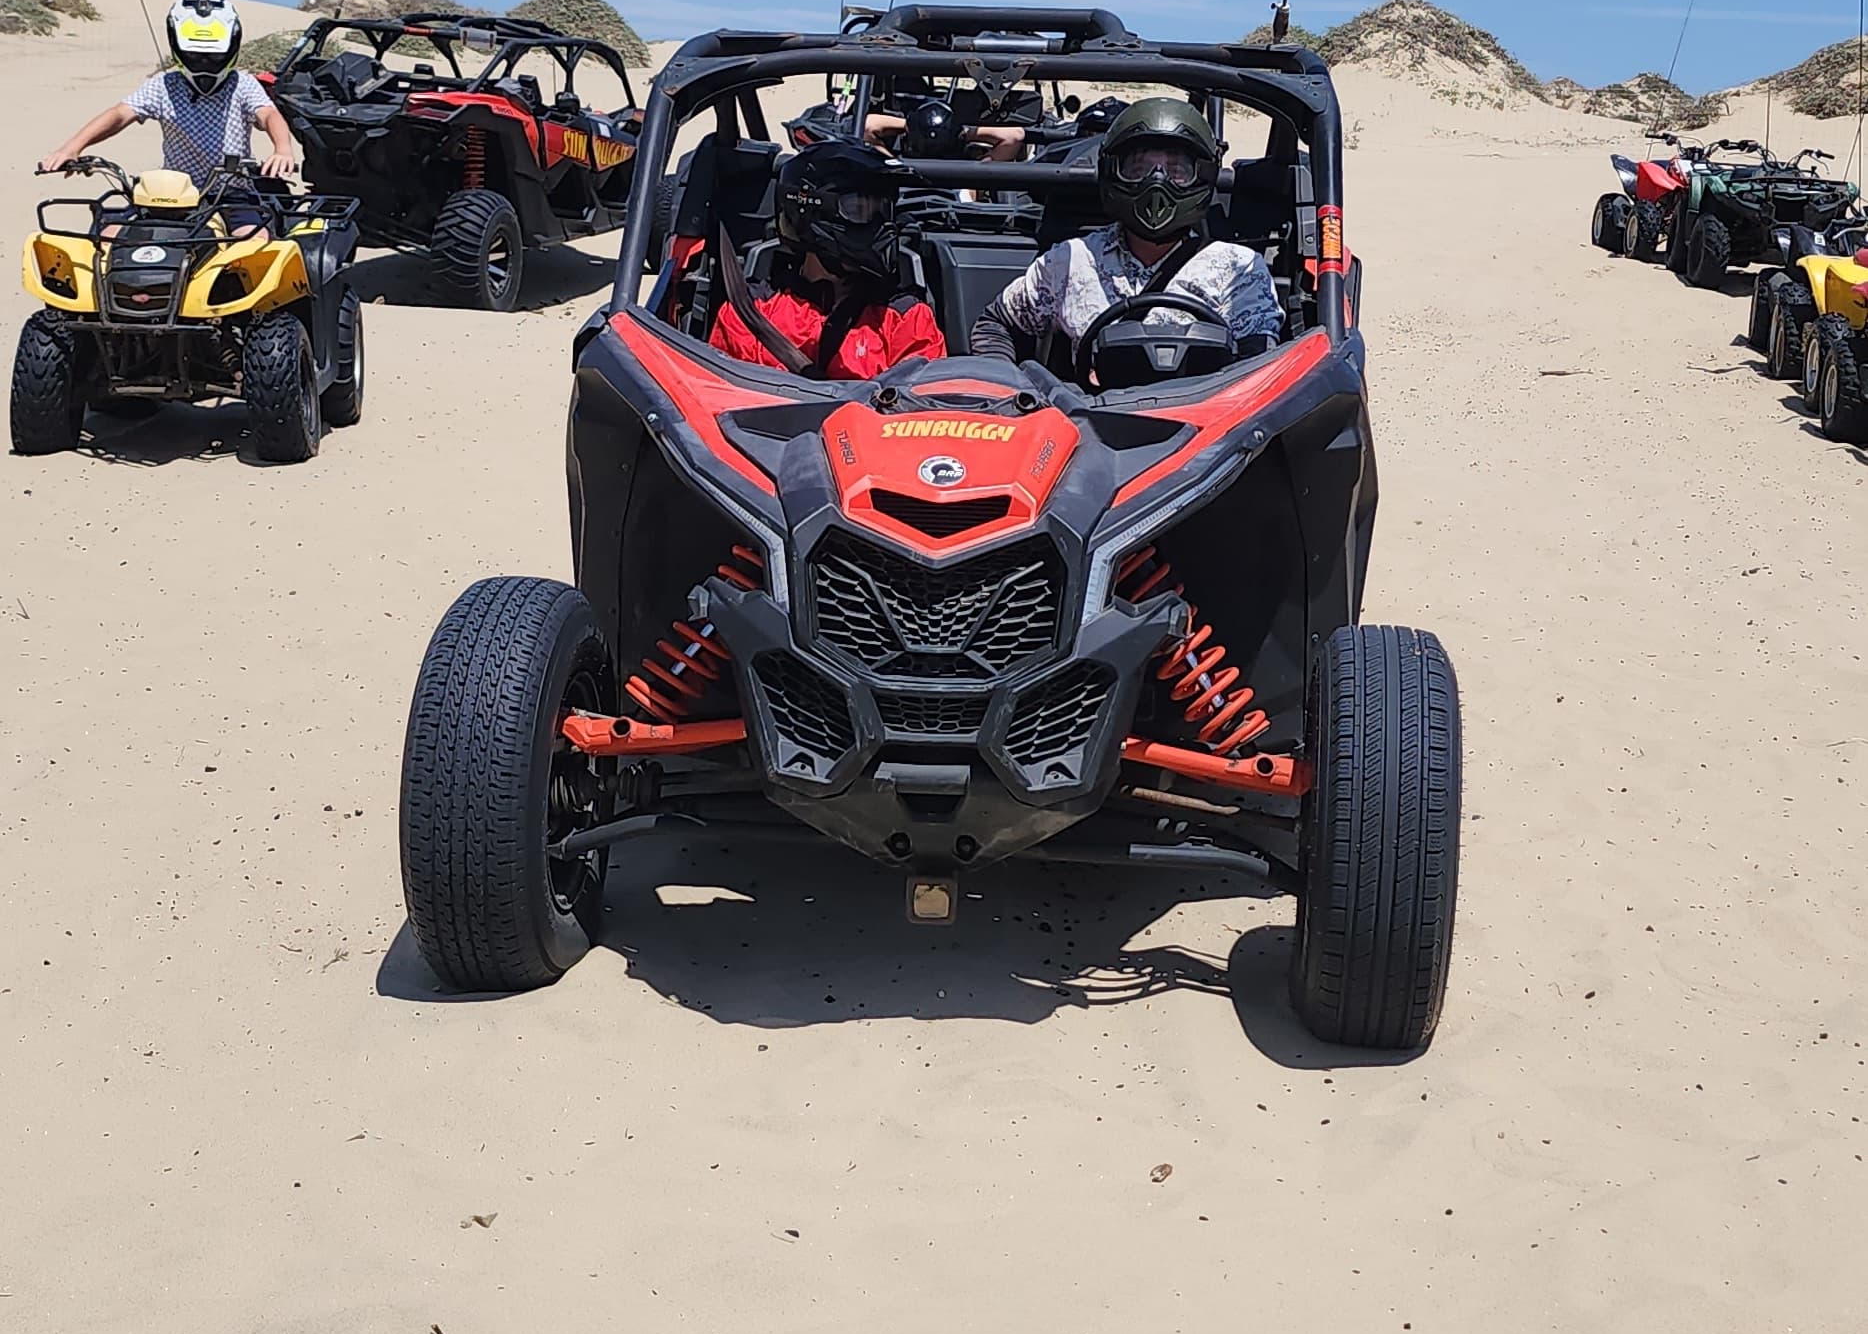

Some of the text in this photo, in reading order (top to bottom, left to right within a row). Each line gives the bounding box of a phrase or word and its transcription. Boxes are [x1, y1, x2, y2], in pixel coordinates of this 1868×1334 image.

[562, 129, 588, 161] SUN
[837, 430, 856, 465] TURBO
[880, 420, 1016, 442] SUNBUGGY
[1031, 437, 1057, 476] TURBO
